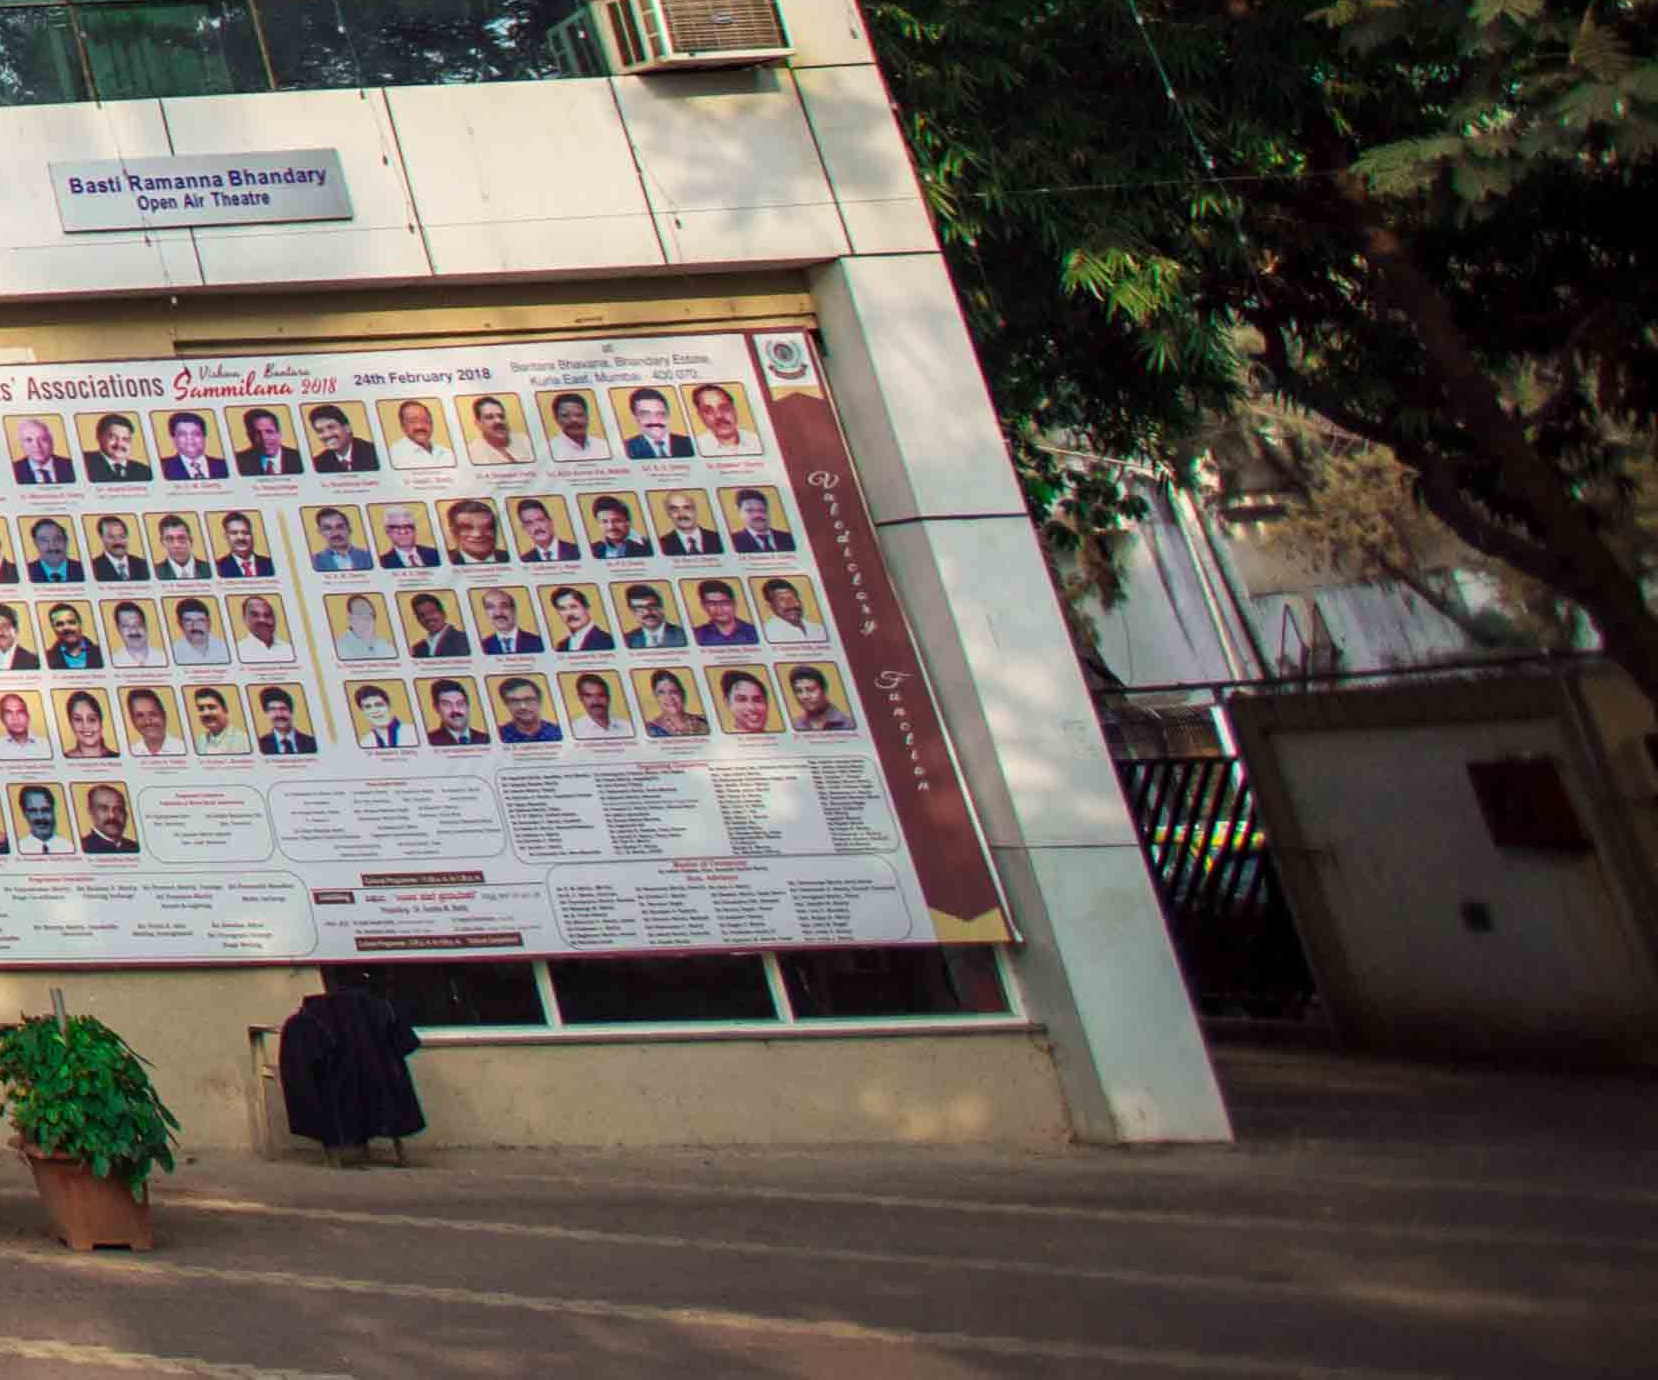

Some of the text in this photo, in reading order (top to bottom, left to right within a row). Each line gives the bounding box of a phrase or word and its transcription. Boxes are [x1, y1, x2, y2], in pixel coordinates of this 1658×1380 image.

[68, 166, 327, 195] Basti Ramanna Bhandary
[137, 190, 271, 213] Open Air Theatre
[27, 373, 165, 401] Associations
[172, 367, 339, 401] Sammilana 2018
[353, 367, 492, 387] 24th February 2018
